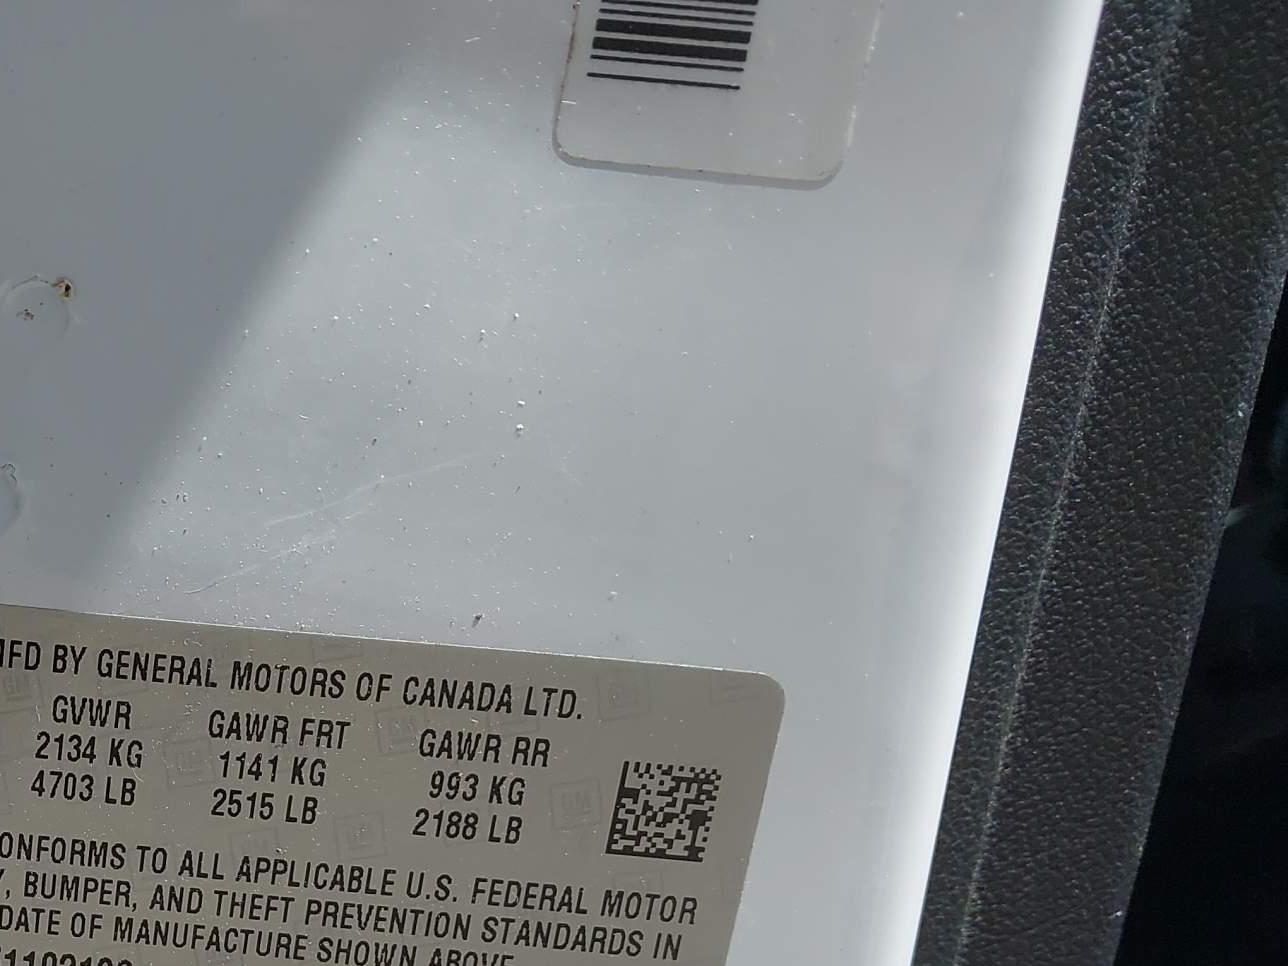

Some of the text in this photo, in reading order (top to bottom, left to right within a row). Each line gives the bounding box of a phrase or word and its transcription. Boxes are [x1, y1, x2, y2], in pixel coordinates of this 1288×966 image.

[52, 644, 87, 675] BY
[97, 649, 217, 687] GENERAL
[230, 660, 345, 700] MOTORS
[355, 671, 392, 702] OF
[402, 677, 513, 714] CANADA
[523, 686, 583, 720] LTD.
[52, 695, 131, 729] GVWR
[208, 710, 289, 745] GAWR
[299, 717, 351, 750] FRT
[35, 732, 97, 764] 2134
[109, 738, 143, 768] KG
[419, 729, 501, 764] GAWR
[511, 736, 551, 768] RR
[218, 751, 279, 781] 1141
[291, 757, 327, 787] KG
[30, 770, 94, 801] 4703
[104, 777, 136, 806] LB
[210, 788, 319, 825] 2515 LB
[429, 770, 477, 802] 993
[488, 775, 526, 806] KG
[412, 808, 478, 841] 2188
[488, 813, 522, 845] LB
[136, 845, 168, 874] TO
[178, 850, 225, 881] ALL
[235, 855, 397, 897] APPLICABLE
[406, 871, 458, 903] U.S.
[471, 877, 588, 915] FEDERAL
[600, 889, 698, 925] MOTOR
[23, 871, 138, 913] BUMPER,
[149, 884, 203, 915] AND
[216, 890, 296, 924] THEFT
[305, 897, 471, 942] PREVENTION
[481, 916, 643, 958] STANDARDS
[653, 932, 682, 962] IN
[71, 911, 103, 939] OF
[112, 916, 309, 961] MANUFACTURE
